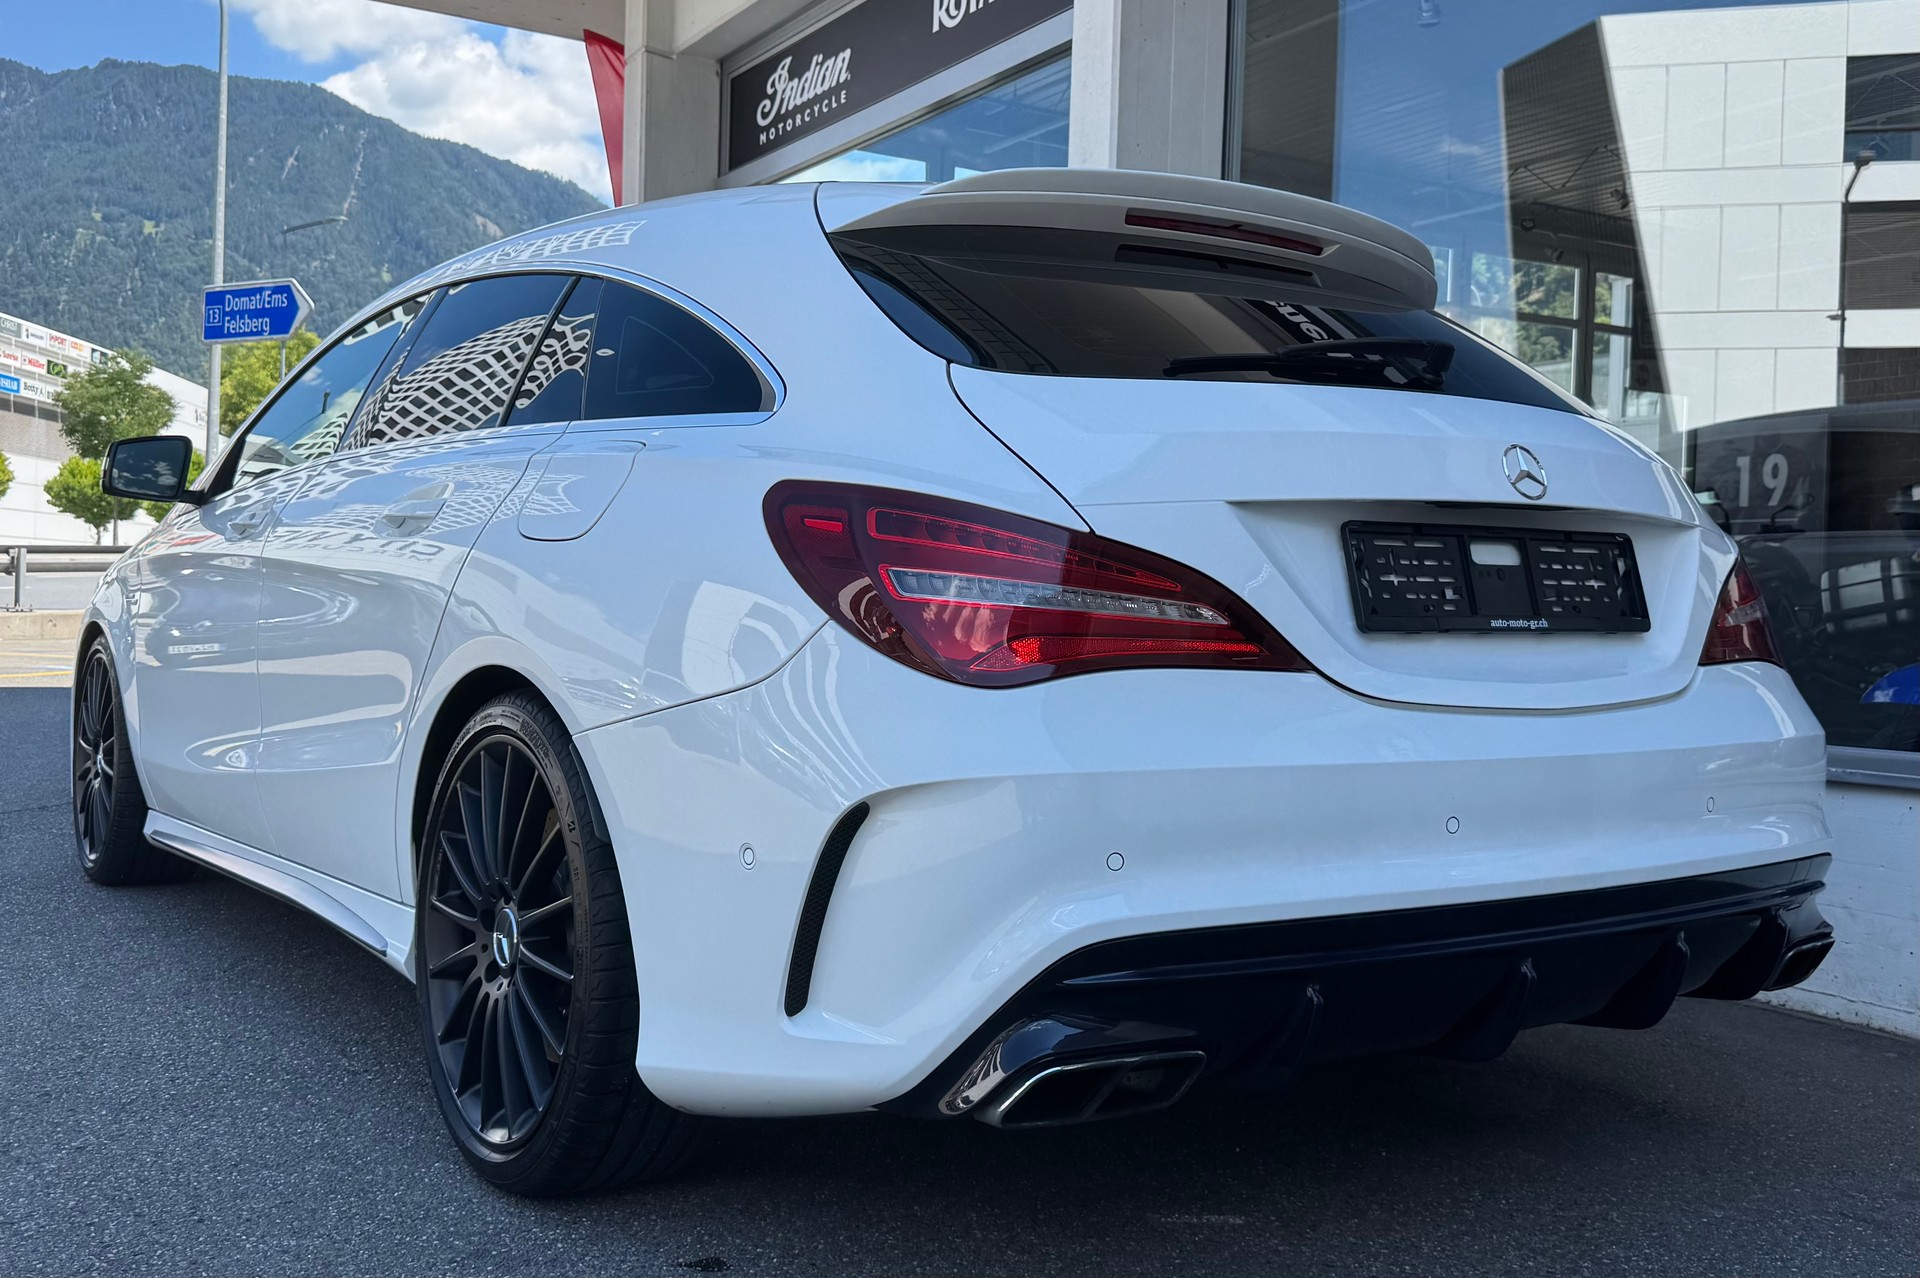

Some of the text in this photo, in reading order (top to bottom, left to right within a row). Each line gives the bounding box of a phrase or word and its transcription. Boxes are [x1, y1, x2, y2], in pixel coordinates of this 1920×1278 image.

[756, 48, 851, 127] Indian
[760, 90, 847, 145] MOTORCYCLE
[225, 290, 288, 312] Domat/Ems
[209, 309, 219, 323] 13
[224, 314, 270, 336] Felsberg
[1736, 453, 1789, 508] 19
[1490, 618, 1549, 630] auto-moto-gr.ch
